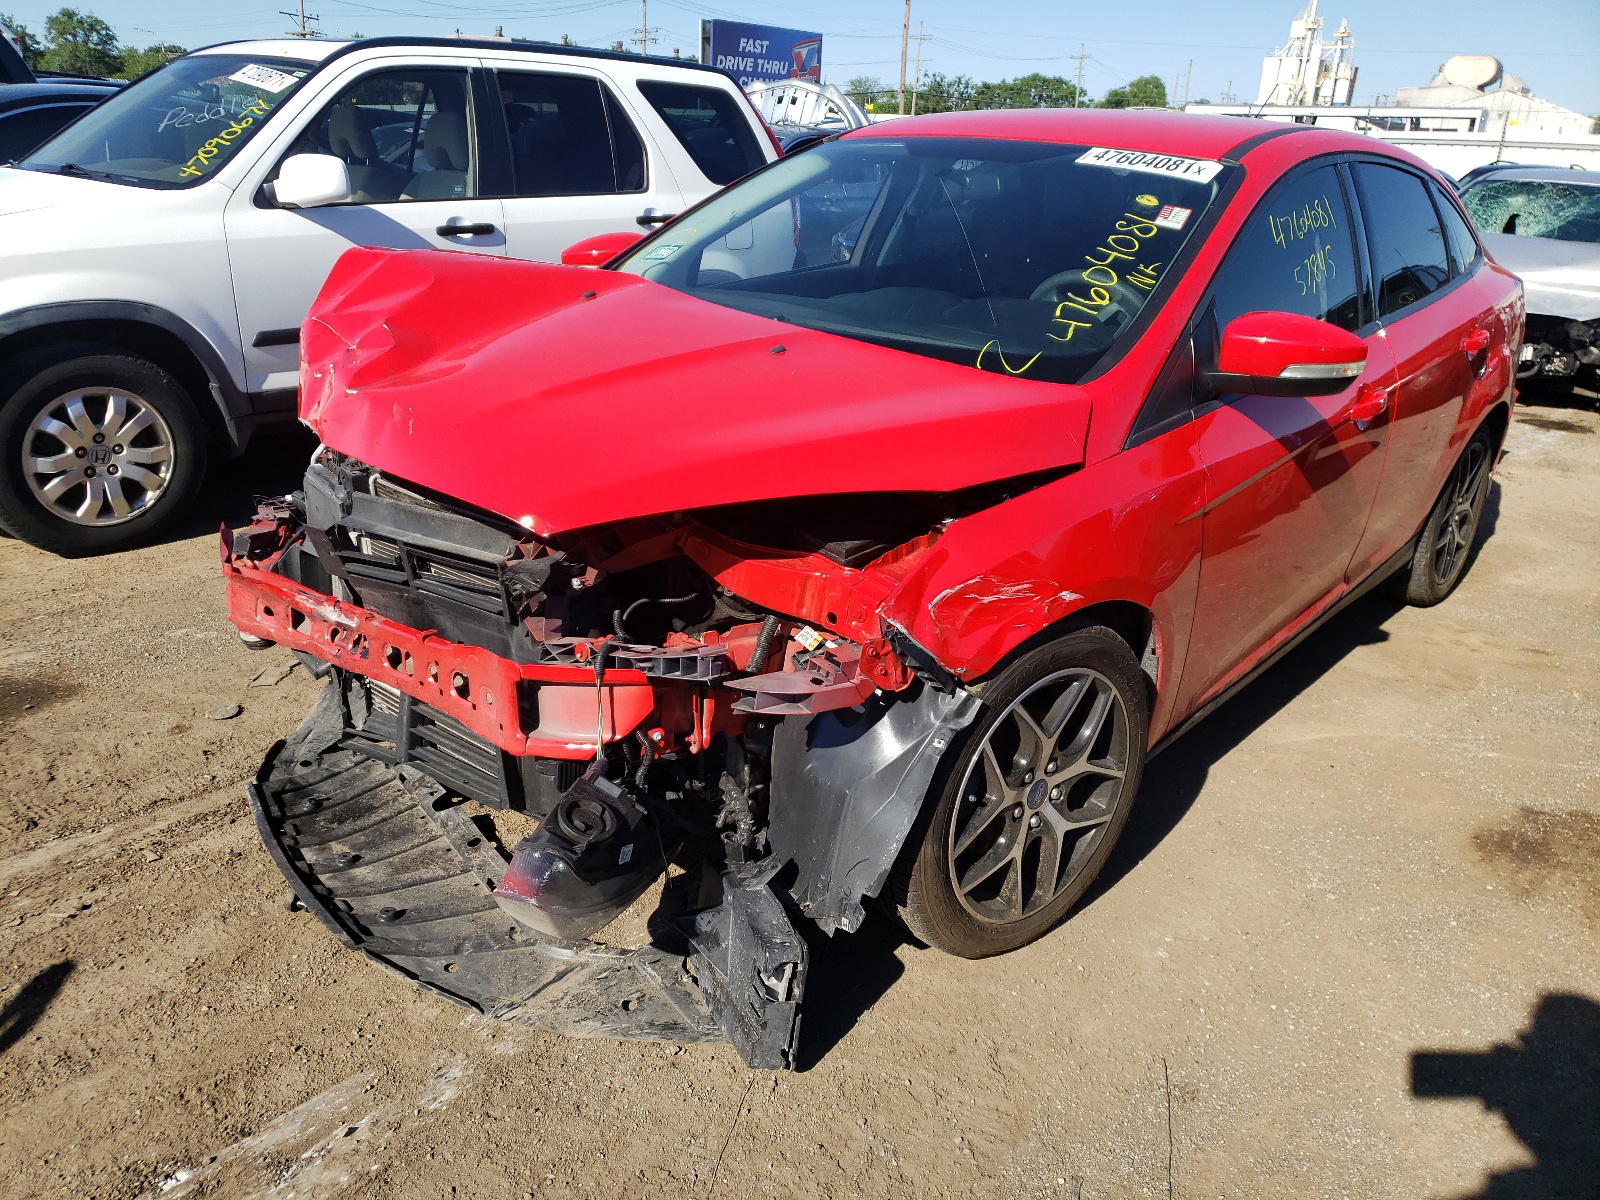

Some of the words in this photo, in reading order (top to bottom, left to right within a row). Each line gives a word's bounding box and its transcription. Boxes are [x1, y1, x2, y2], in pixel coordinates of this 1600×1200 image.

[738, 38, 769, 54] FAST
[716, 55, 754, 72] DRIVE
[757, 59, 788, 75] THRU
[1046, 213, 1158, 342] 47604081
